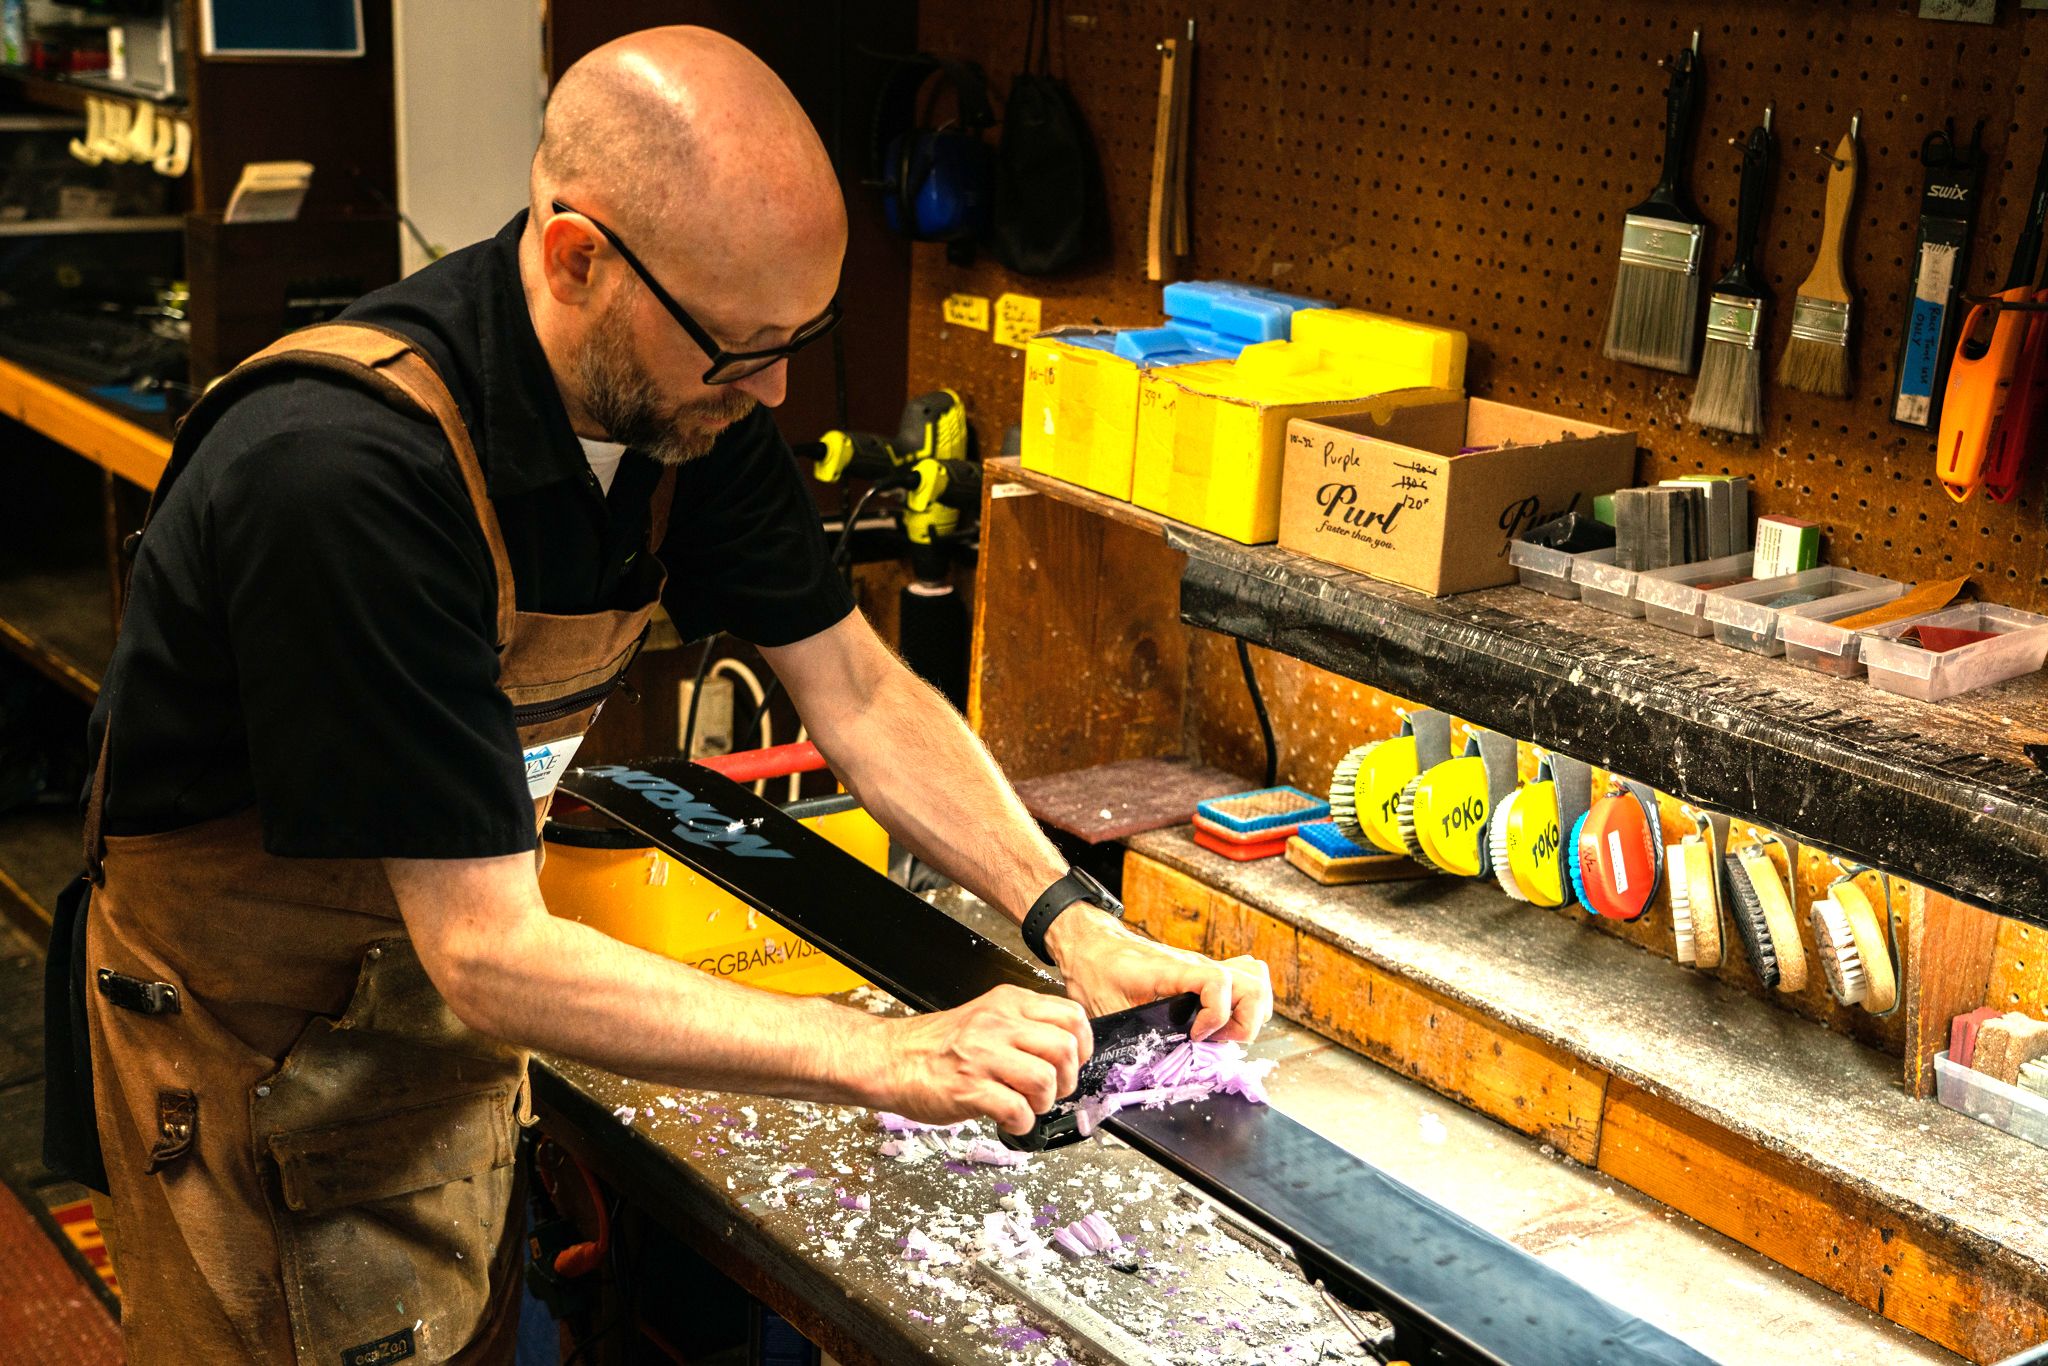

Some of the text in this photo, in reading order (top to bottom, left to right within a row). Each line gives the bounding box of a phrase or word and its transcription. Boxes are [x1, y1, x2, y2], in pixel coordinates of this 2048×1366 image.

[1324, 441, 1361, 473] Purple
[1315, 482, 1402, 535] Purl
[1315, 519, 1350, 536] faster
[1351, 528, 1372, 544] than
[1441, 795, 1484, 839] TOKO
[1531, 819, 1560, 869] TOKO
[686, 943, 777, 976] GGBAR
